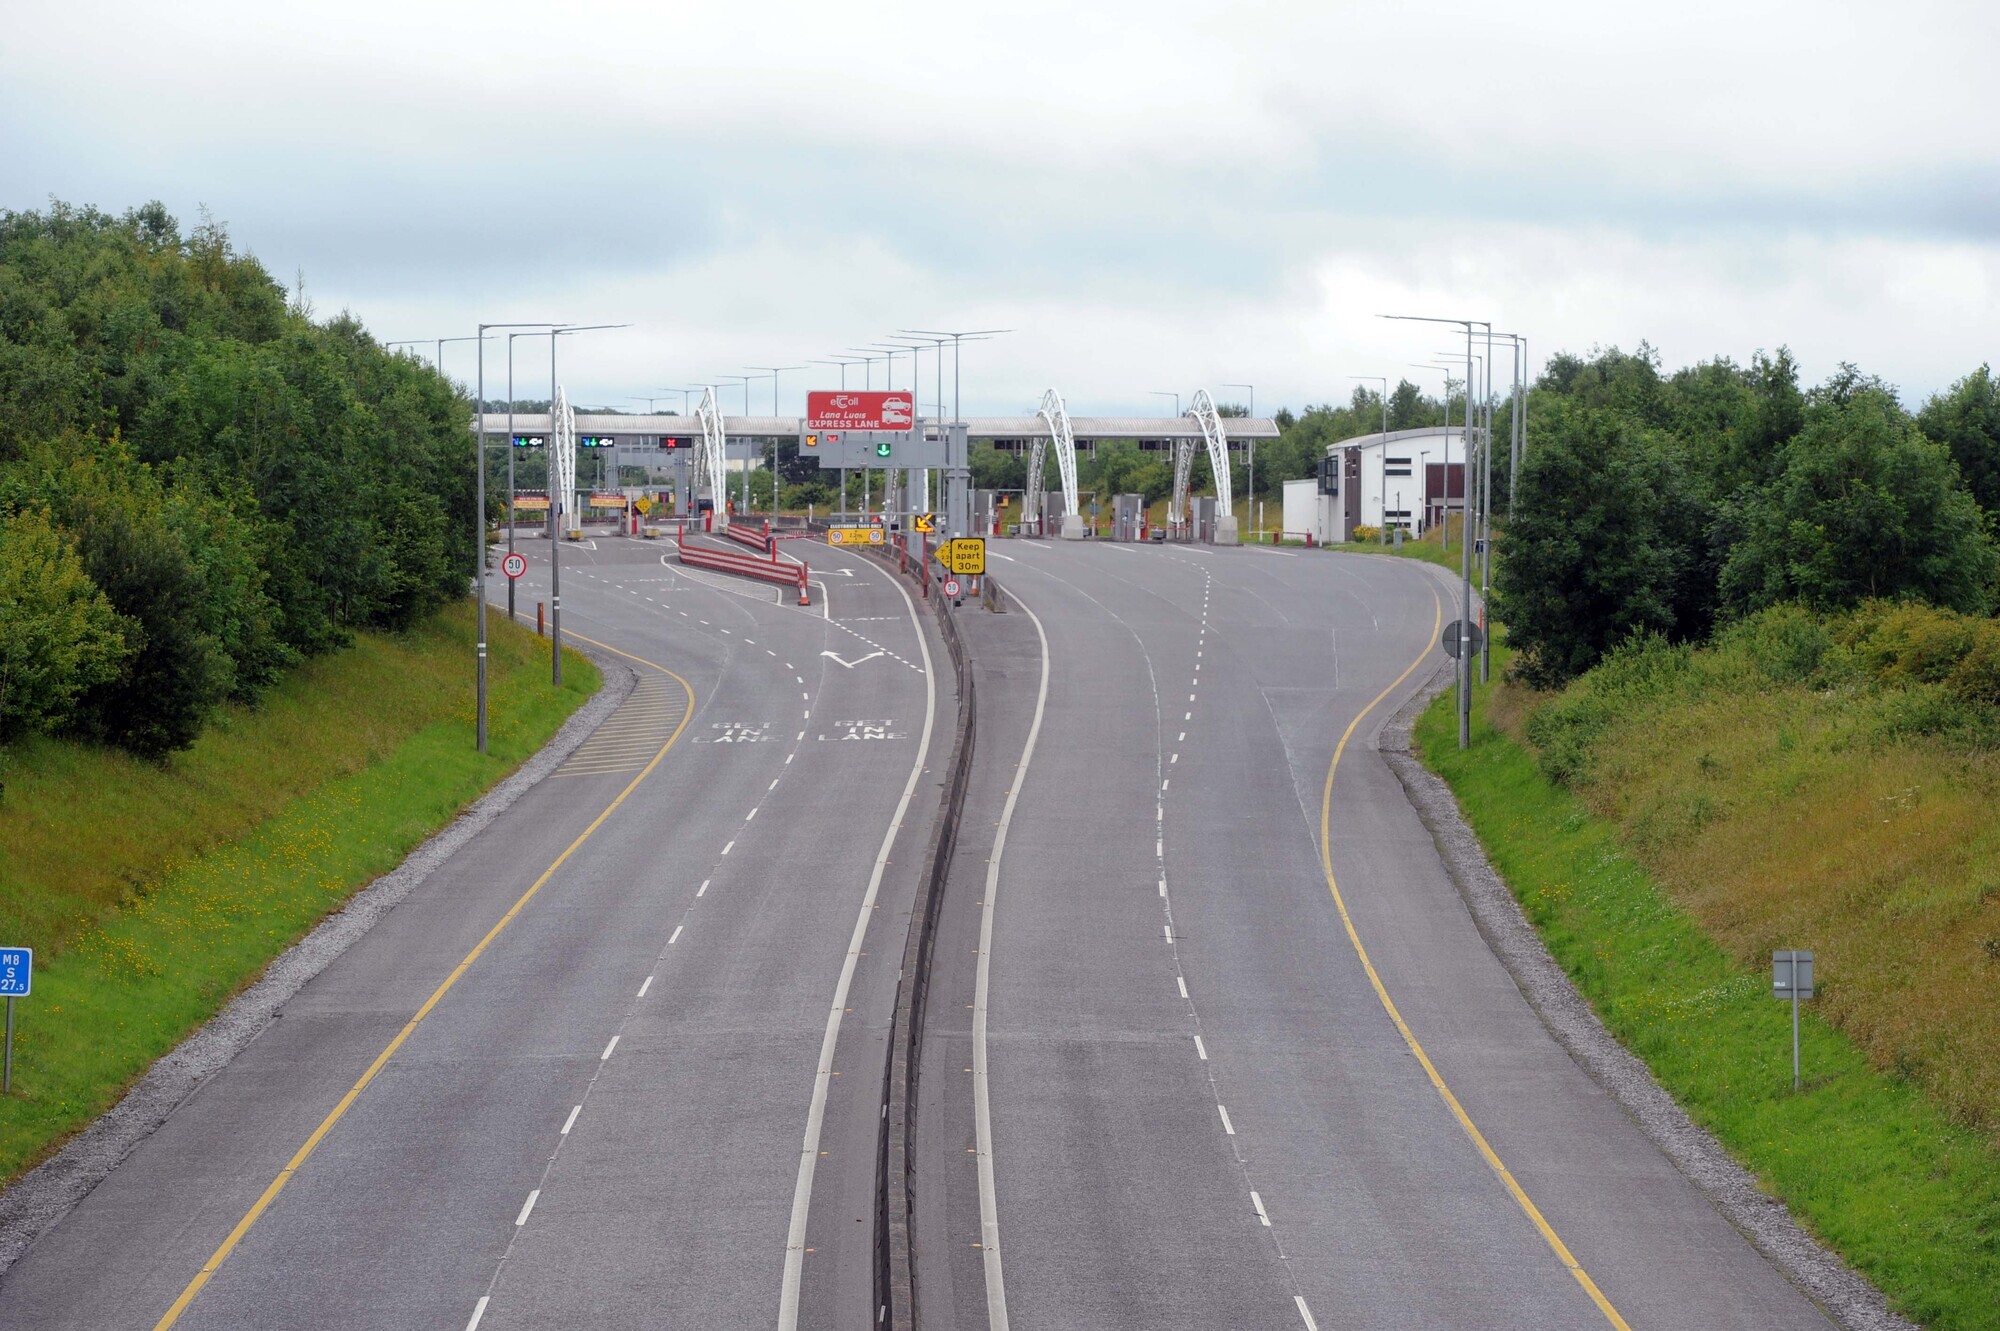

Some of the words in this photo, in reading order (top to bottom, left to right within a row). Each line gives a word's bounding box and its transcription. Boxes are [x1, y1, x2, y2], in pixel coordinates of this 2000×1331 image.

[808, 419, 852, 428] EXPRESS
[855, 419, 880, 428] LANE
[957, 543, 980, 551] Keep
[508, 559, 521, 569] 50
[958, 562, 980, 570] 30m
[947, 583, 957, 591] 50
[691, 735, 783, 743] LANE
[818, 732, 908, 741] LANE
[3, 954, 20, 965] M8
[6, 967, 15, 978] S
[1, 979, 24, 991] 27.5
